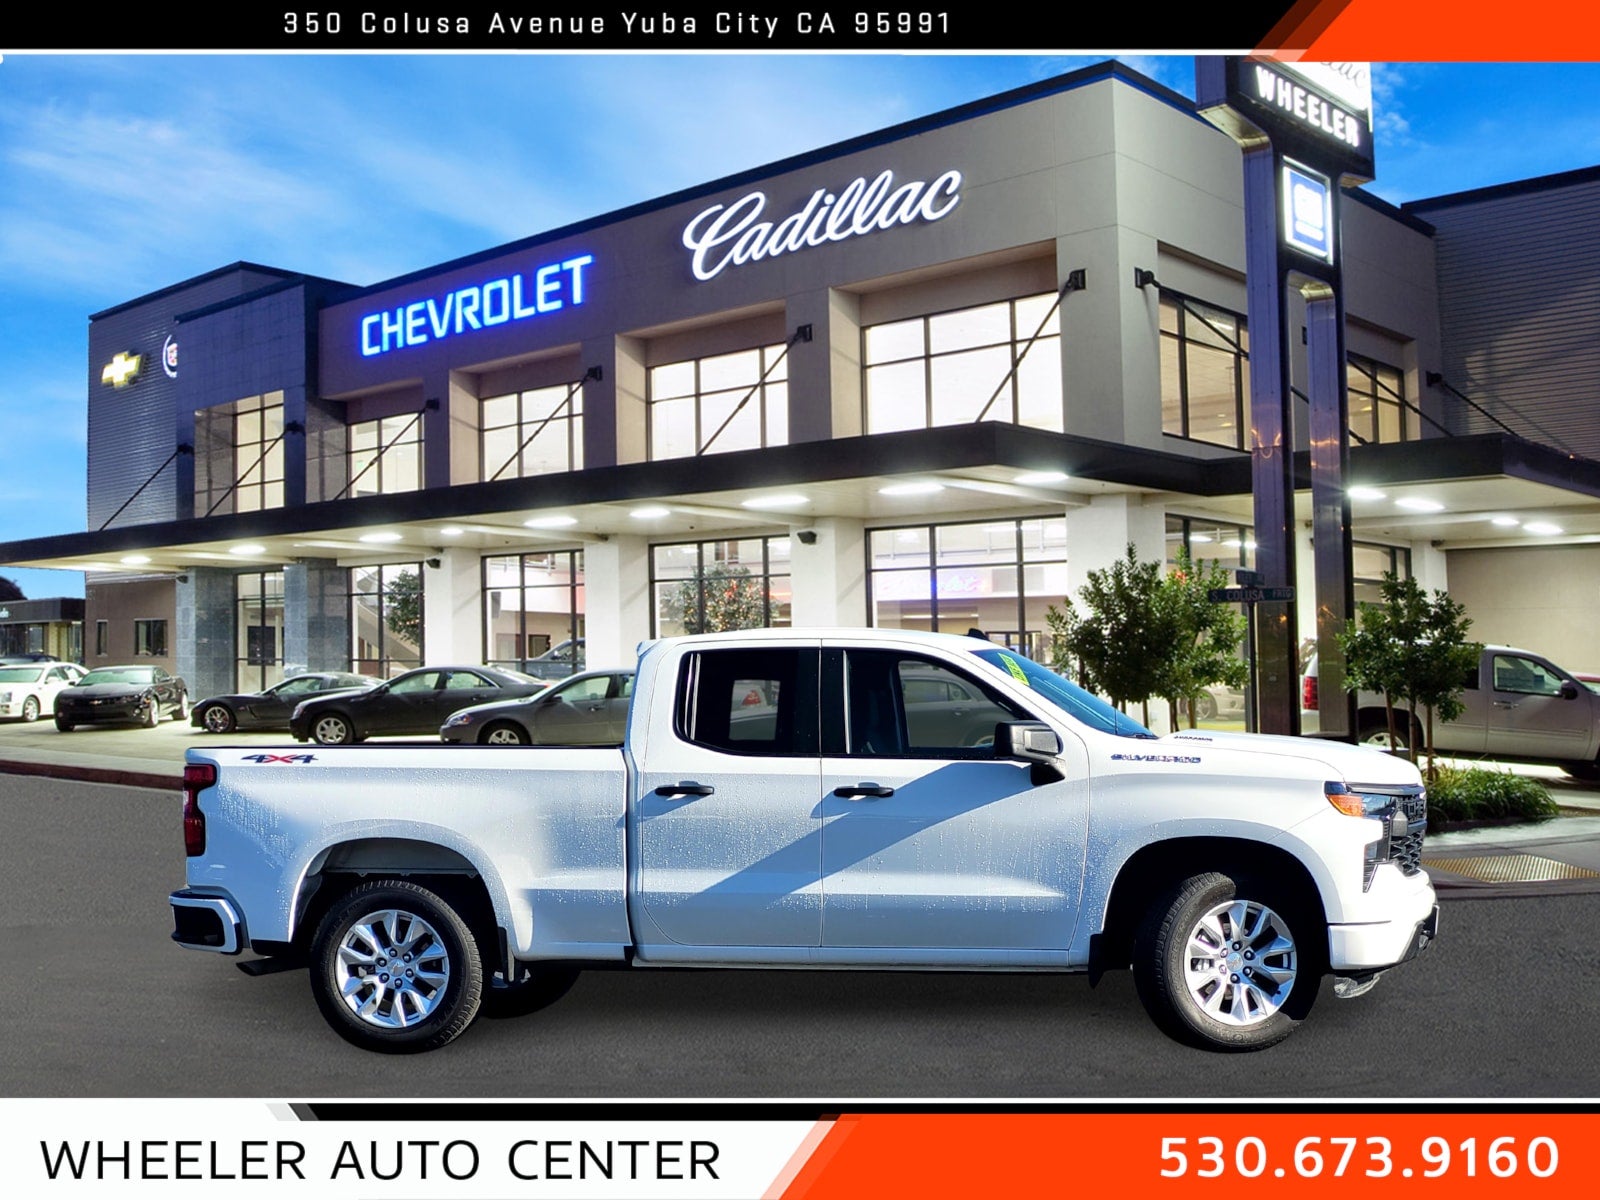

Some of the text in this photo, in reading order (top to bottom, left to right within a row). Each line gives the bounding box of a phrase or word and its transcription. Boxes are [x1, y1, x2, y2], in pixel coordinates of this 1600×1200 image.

[1256, 65, 1360, 148] WHEELER
[682, 169, 962, 281] Cadillac
[361, 254, 593, 356] CHEVROLET
[1226, 589, 1265, 601] COLUSA
